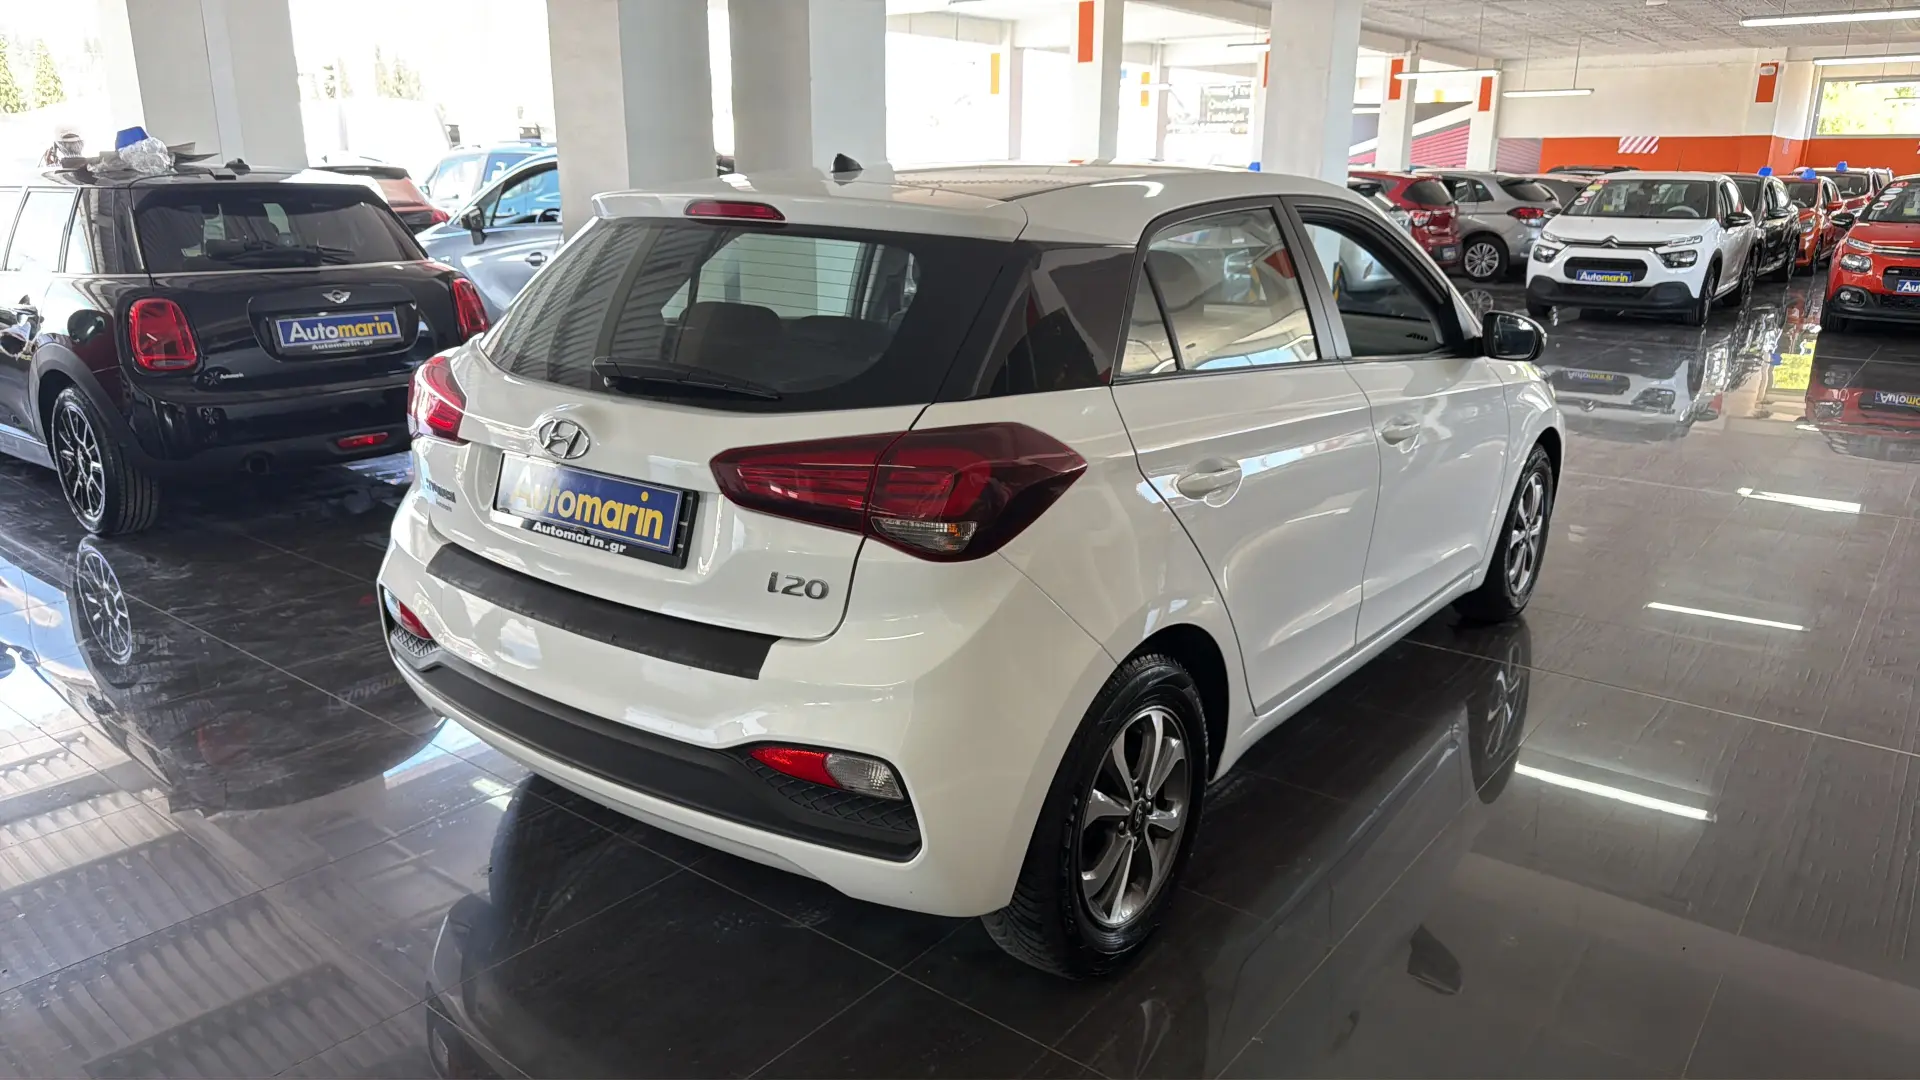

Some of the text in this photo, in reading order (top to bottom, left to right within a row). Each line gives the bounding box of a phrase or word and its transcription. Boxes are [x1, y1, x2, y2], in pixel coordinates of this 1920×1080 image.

[1580, 270, 1628, 283] Automarin
[290, 316, 392, 342] Automarin
[312, 340, 373, 350] Automarin.gr
[510, 465, 664, 540] Automarin
[532, 521, 627, 554] Automarin.gr
[767, 571, 830, 600] i20
